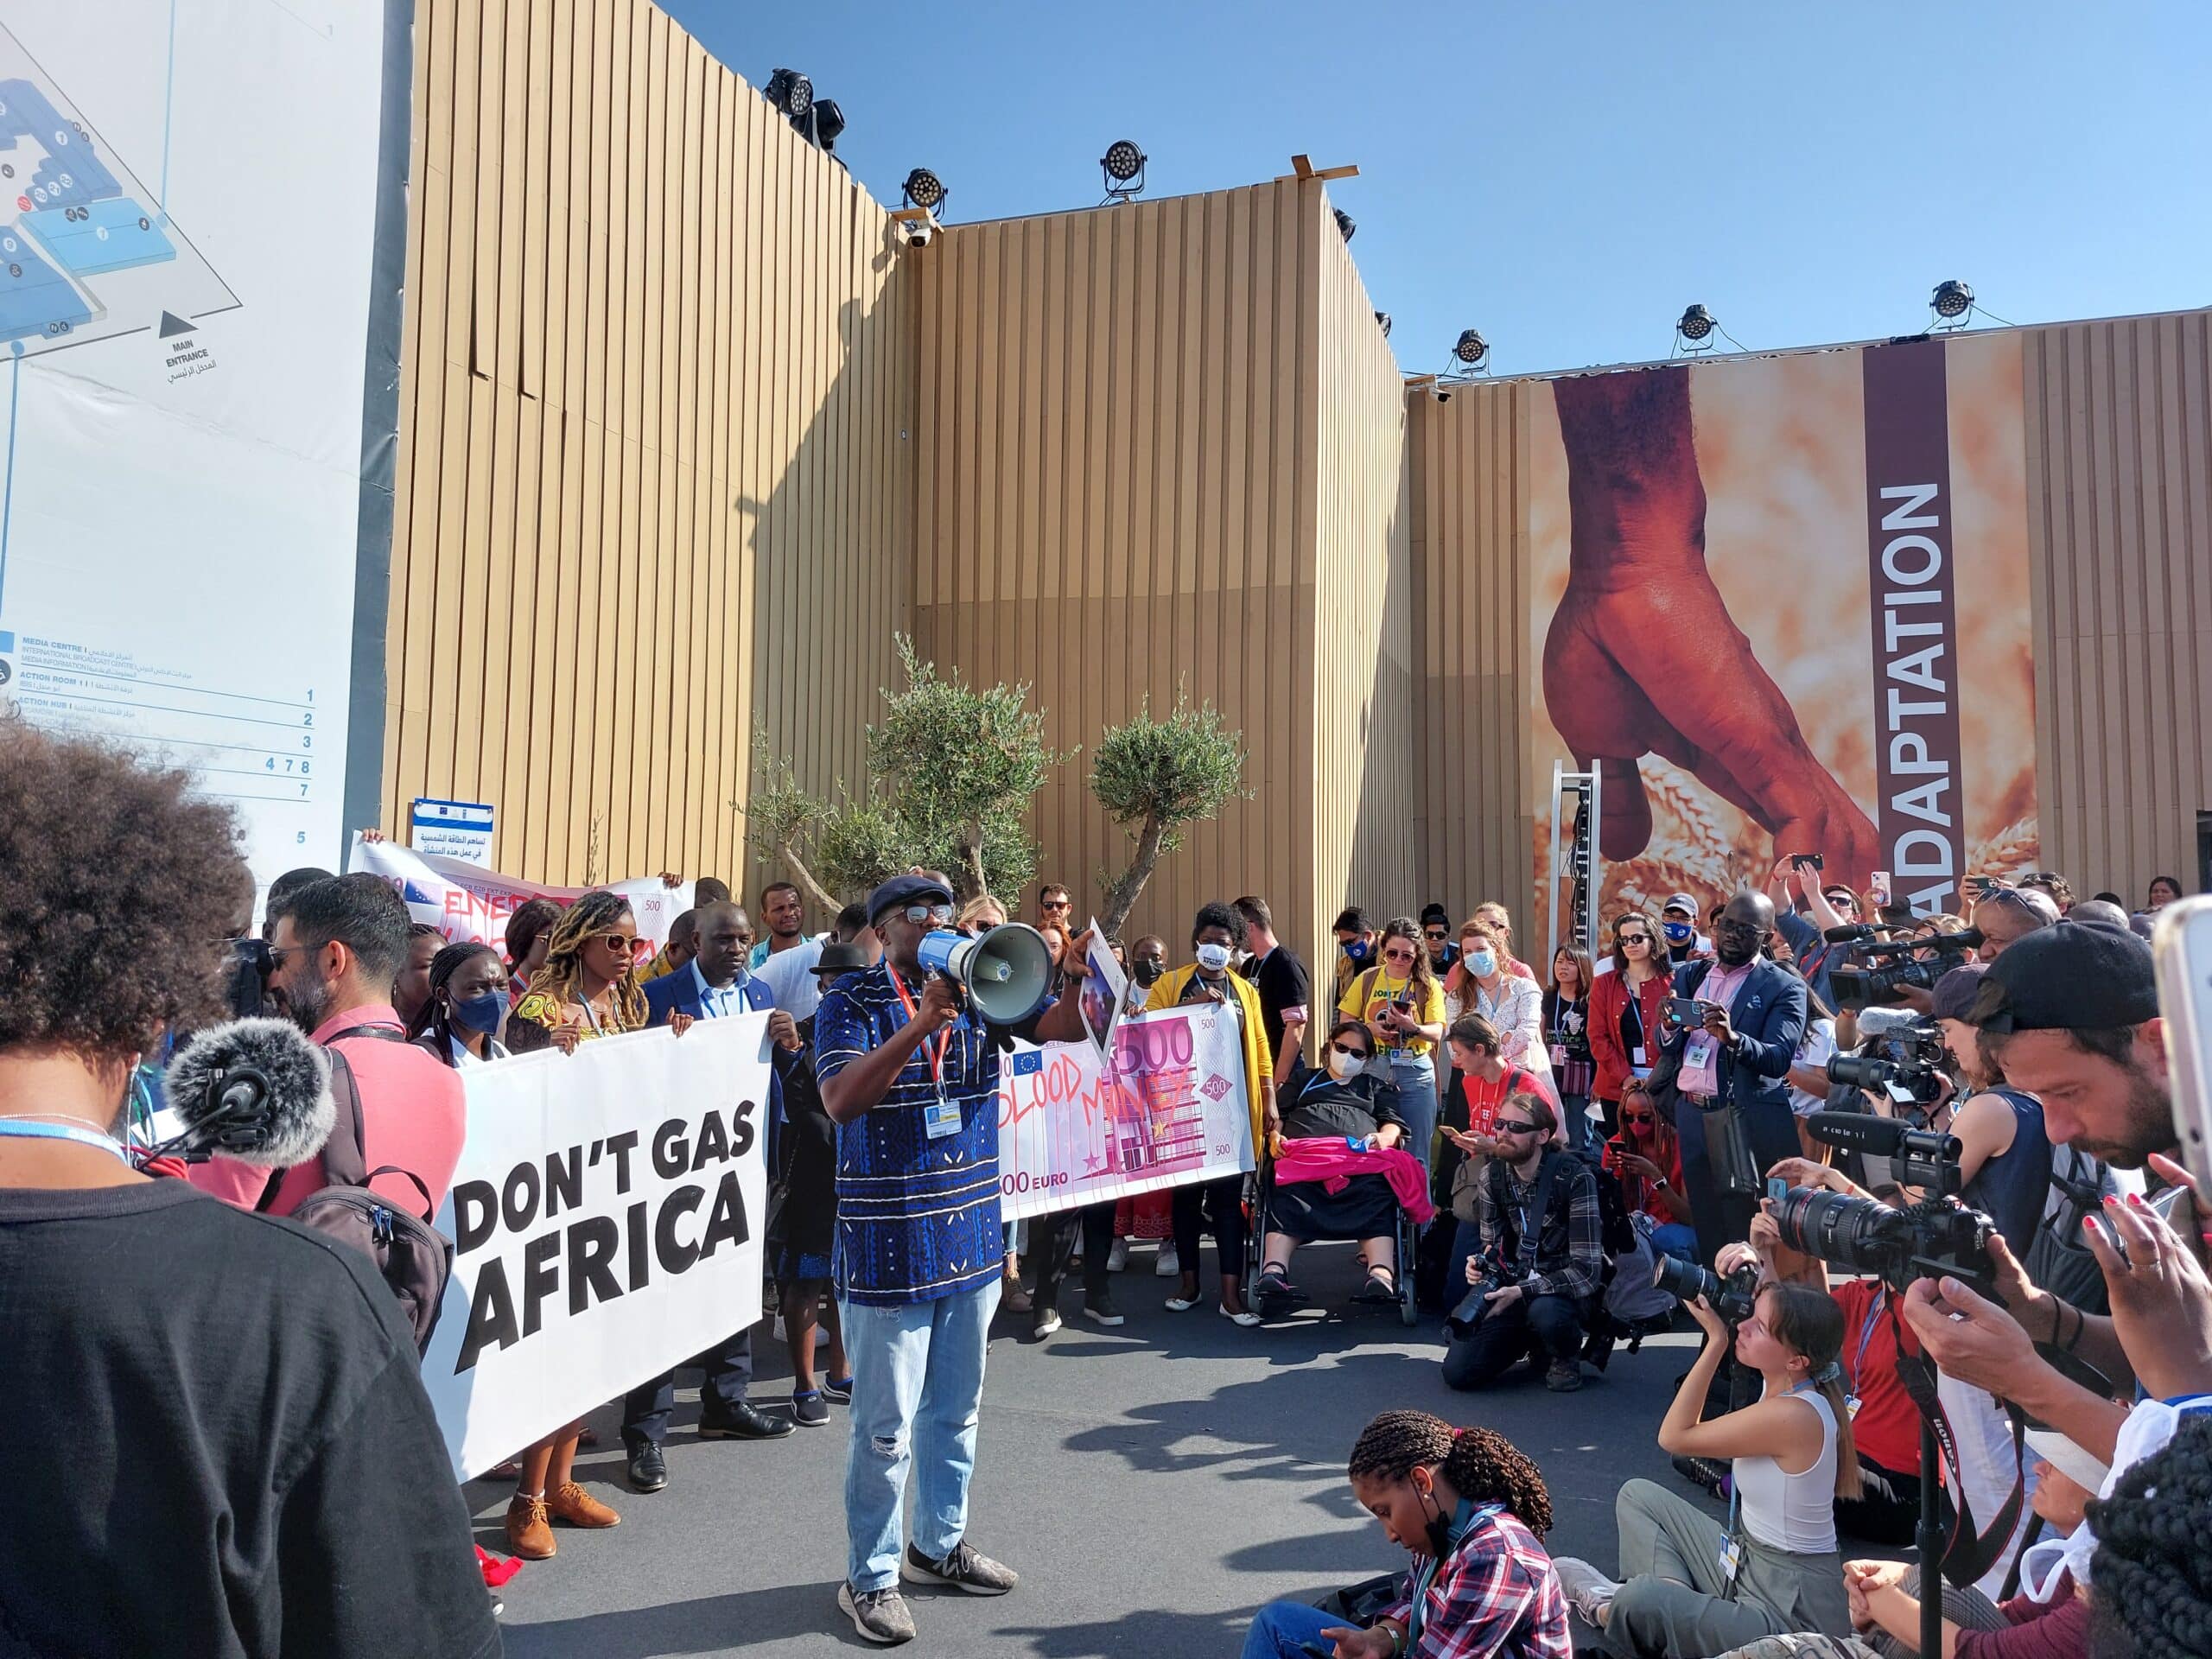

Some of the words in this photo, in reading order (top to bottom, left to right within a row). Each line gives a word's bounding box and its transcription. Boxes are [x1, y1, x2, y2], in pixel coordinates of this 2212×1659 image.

[173, 339, 194, 353] MAIN
[166, 348, 209, 367] ENTRANCE
[195, 359, 217, 375] المدخل
[167, 365, 195, 385] الرئيسي
[22, 636, 48, 647] MEDIA
[51, 640, 82, 653] CENTRE
[20, 671, 50, 682] ACTION
[53, 675, 76, 685] ROOM
[18, 696, 48, 707] ACTION
[307, 689, 314, 702] 1
[1879, 483, 1954, 919] ADAPTATION
[303, 713, 312, 726] 2
[302, 735, 311, 748] 3
[265, 757, 275, 771] 4
[285, 759, 294, 772] 7
[301, 760, 310, 774] 8
[300, 784, 308, 797] 7
[296, 830, 306, 844] 5
[420, 833, 447, 843] الشمسية
[448, 834, 467, 844] الطاقة
[460, 848, 471, 857] عمل
[473, 849, 481, 861] في
[445, 889, 529, 920] ENER
[645, 899, 661, 912] 500
[1201, 1018, 1215, 1029] 500
[1117, 1019, 1194, 1075] 500
[1205, 1079, 1226, 1096] 500
[1082, 1065, 1194, 1128] MONEY
[1215, 1142, 1230, 1156] 500
[453, 1129, 639, 1255] DON'T
[652, 1099, 755, 1180] GAS
[999, 1171, 1029, 1196] 00
[1032, 1171, 1069, 1190] EURO
[454, 1170, 750, 1376] AFRICA
